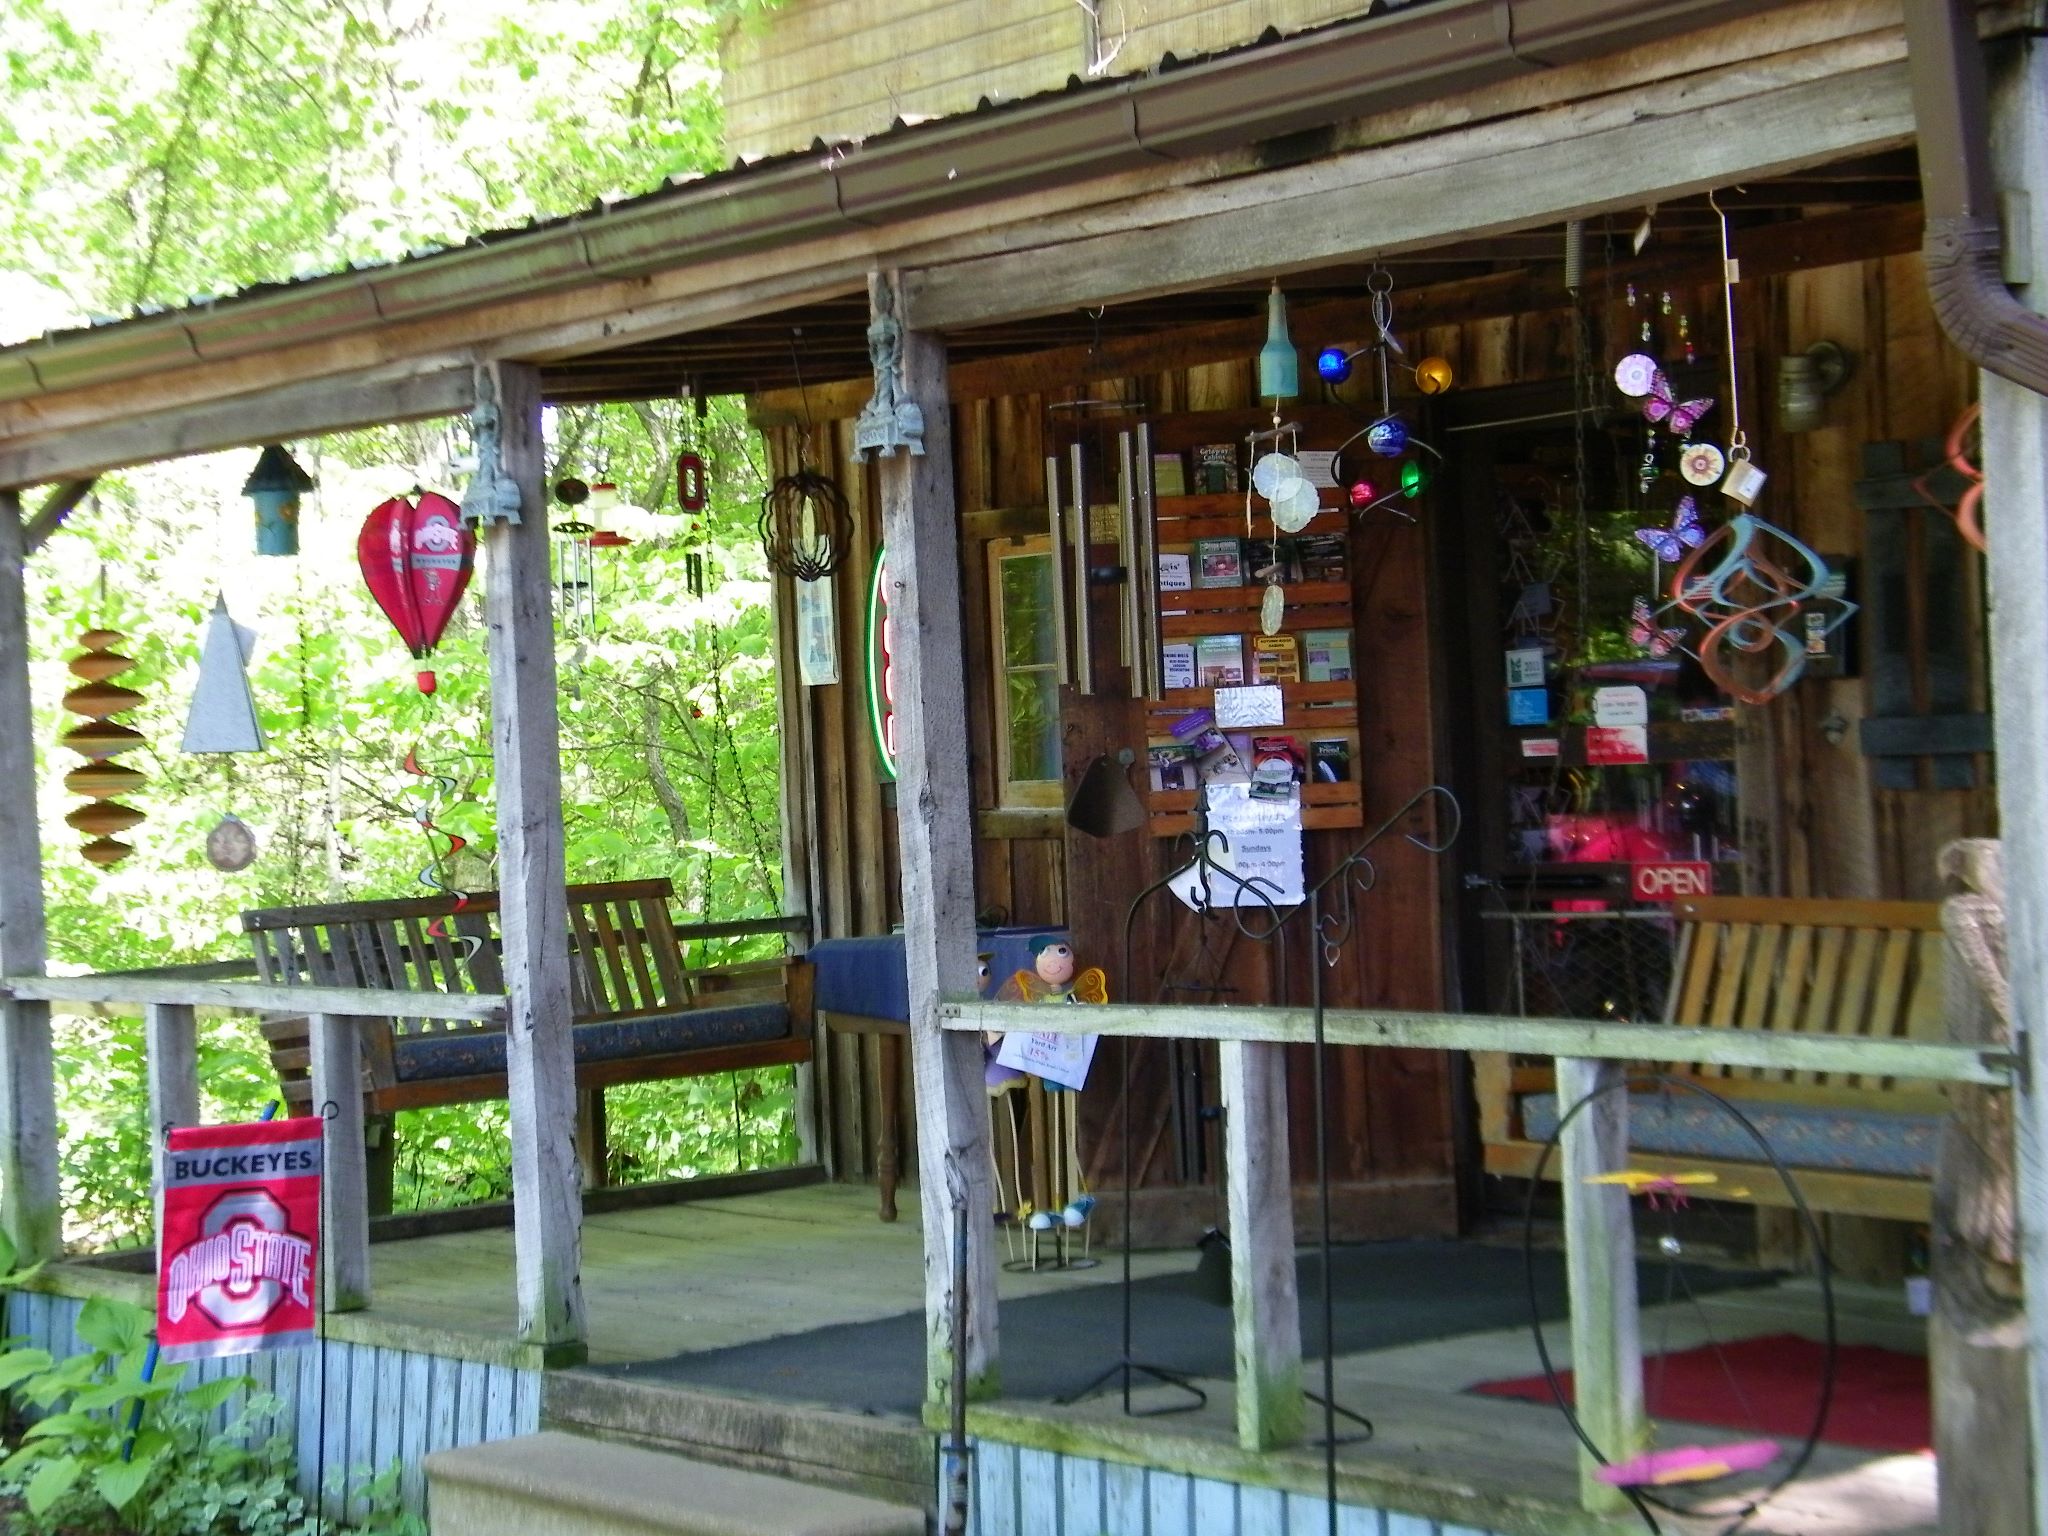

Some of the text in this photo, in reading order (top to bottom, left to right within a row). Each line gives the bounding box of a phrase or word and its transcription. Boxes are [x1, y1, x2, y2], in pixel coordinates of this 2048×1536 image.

[1241, 845, 1272, 853] Sundays
[1639, 868, 1706, 894] OPEN
[175, 1150, 313, 1180] BUCKEYES
